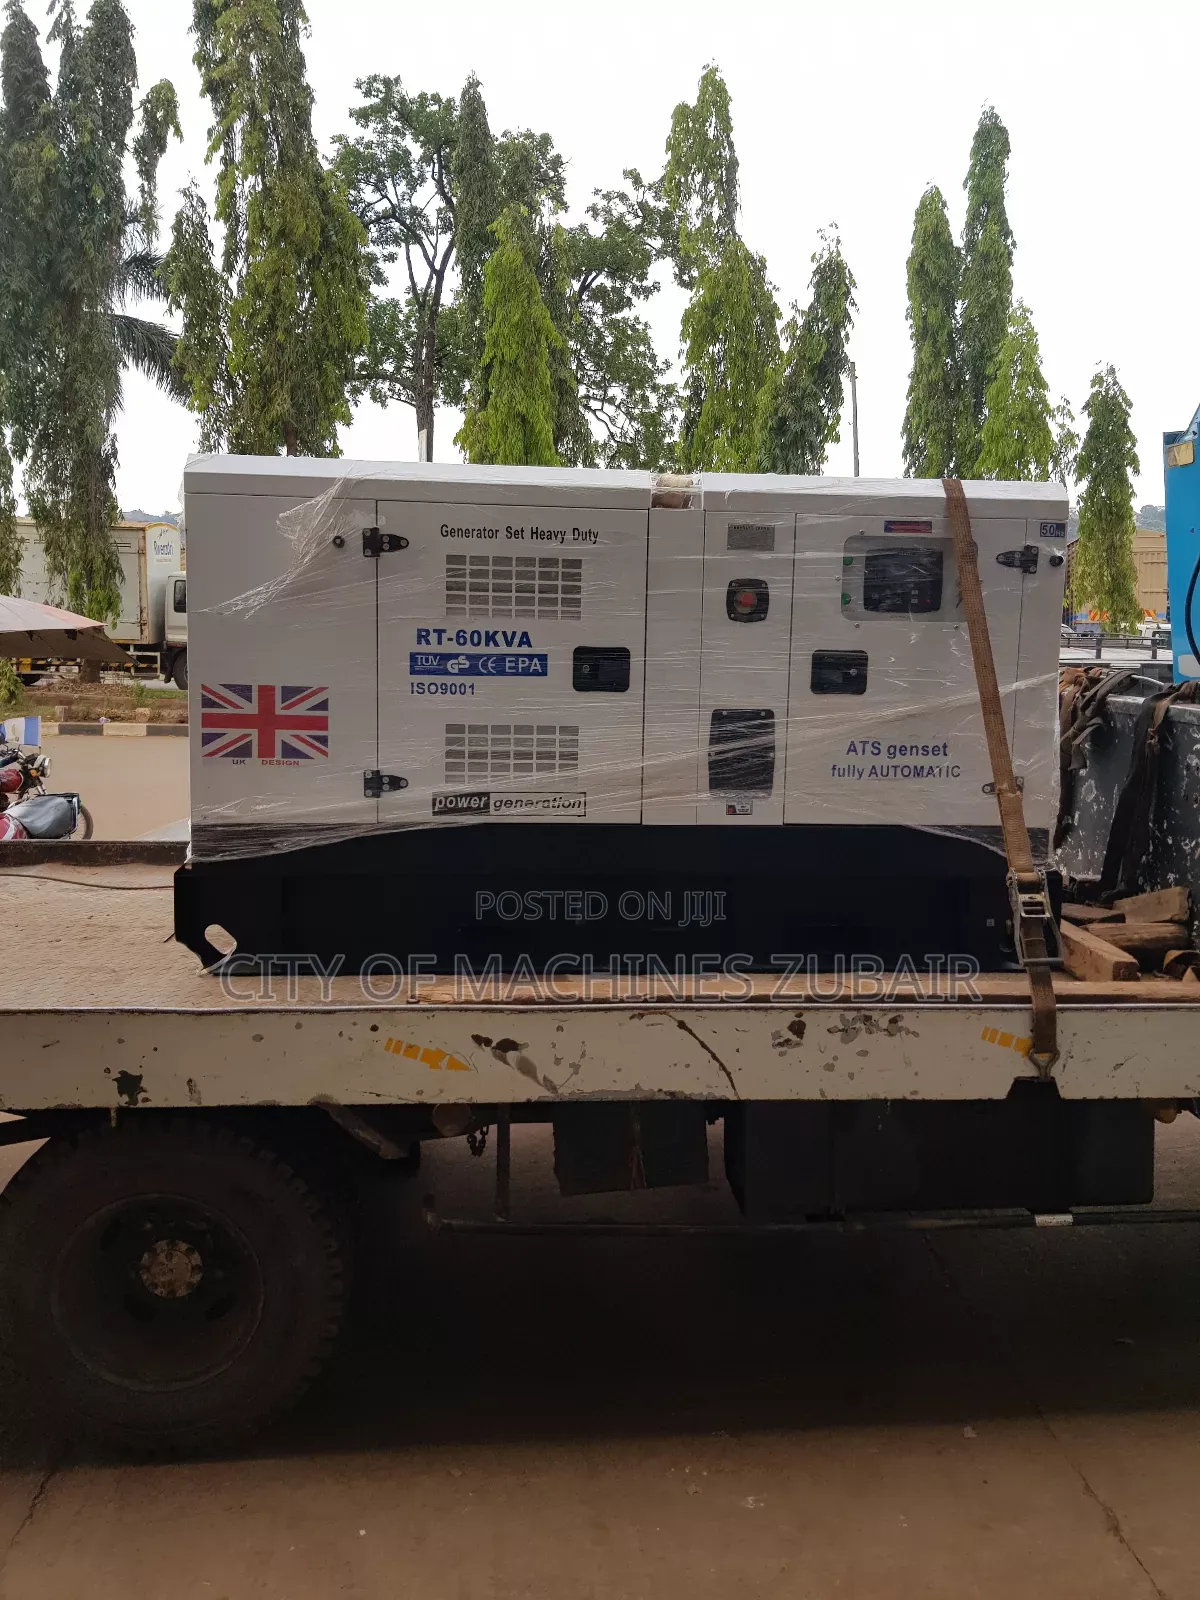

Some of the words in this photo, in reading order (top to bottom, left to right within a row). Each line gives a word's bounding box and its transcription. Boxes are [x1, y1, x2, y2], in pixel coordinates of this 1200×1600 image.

[440, 524, 500, 540] Generator
[505, 525, 525, 540] Set
[530, 526, 567, 544] Heavy
[572, 527, 599, 545] Duty
[416, 628, 533, 648] RT-60KVA
[505, 657, 543, 673] EPA
[410, 682, 475, 695] ISO9001
[845, 740, 882, 756] ATS
[886, 742, 948, 760] genset
[831, 764, 865, 780] fully
[867, 764, 961, 778] AUTOMATIC
[434, 796, 488, 812] power
[493, 796, 581, 811] generation
